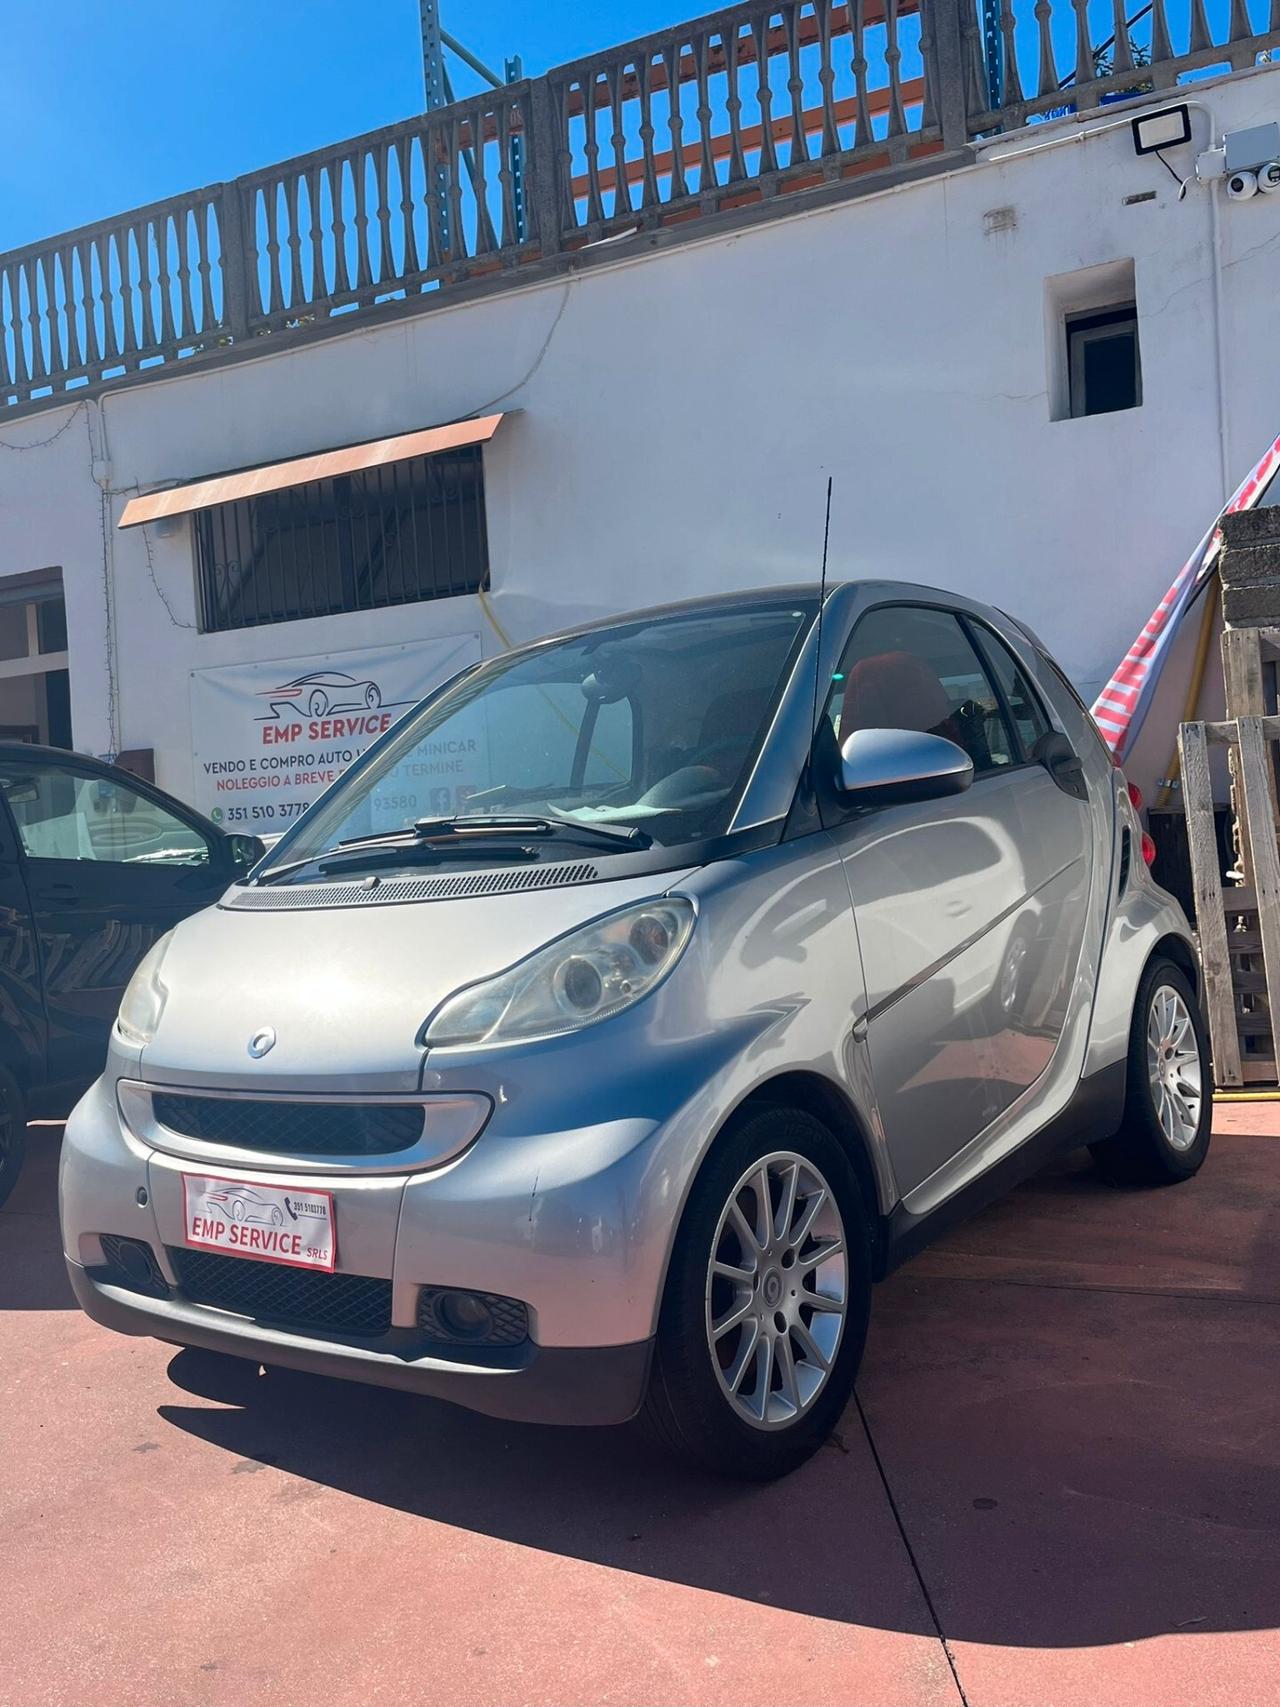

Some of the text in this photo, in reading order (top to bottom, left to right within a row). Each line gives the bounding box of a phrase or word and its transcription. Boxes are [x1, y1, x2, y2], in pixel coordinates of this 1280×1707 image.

[262, 713, 392, 745] EMP SERVICE
[203, 759, 246, 775] VENDO
[249, 758, 257, 771] E
[260, 753, 315, 771] COMPRO
[318, 749, 353, 765] AUTO
[416, 739, 477, 756] MINICAR
[216, 774, 281, 791] NOLEGGIO
[283, 774, 292, 787] A
[294, 770, 335, 785] BREVE
[403, 759, 464, 777] TERMINE
[227, 807, 249, 821] 351
[252, 805, 275, 819] 510
[293, 1201, 304, 1213] 351
[192, 1217, 328, 1261] EMP SERVICE SRLS
